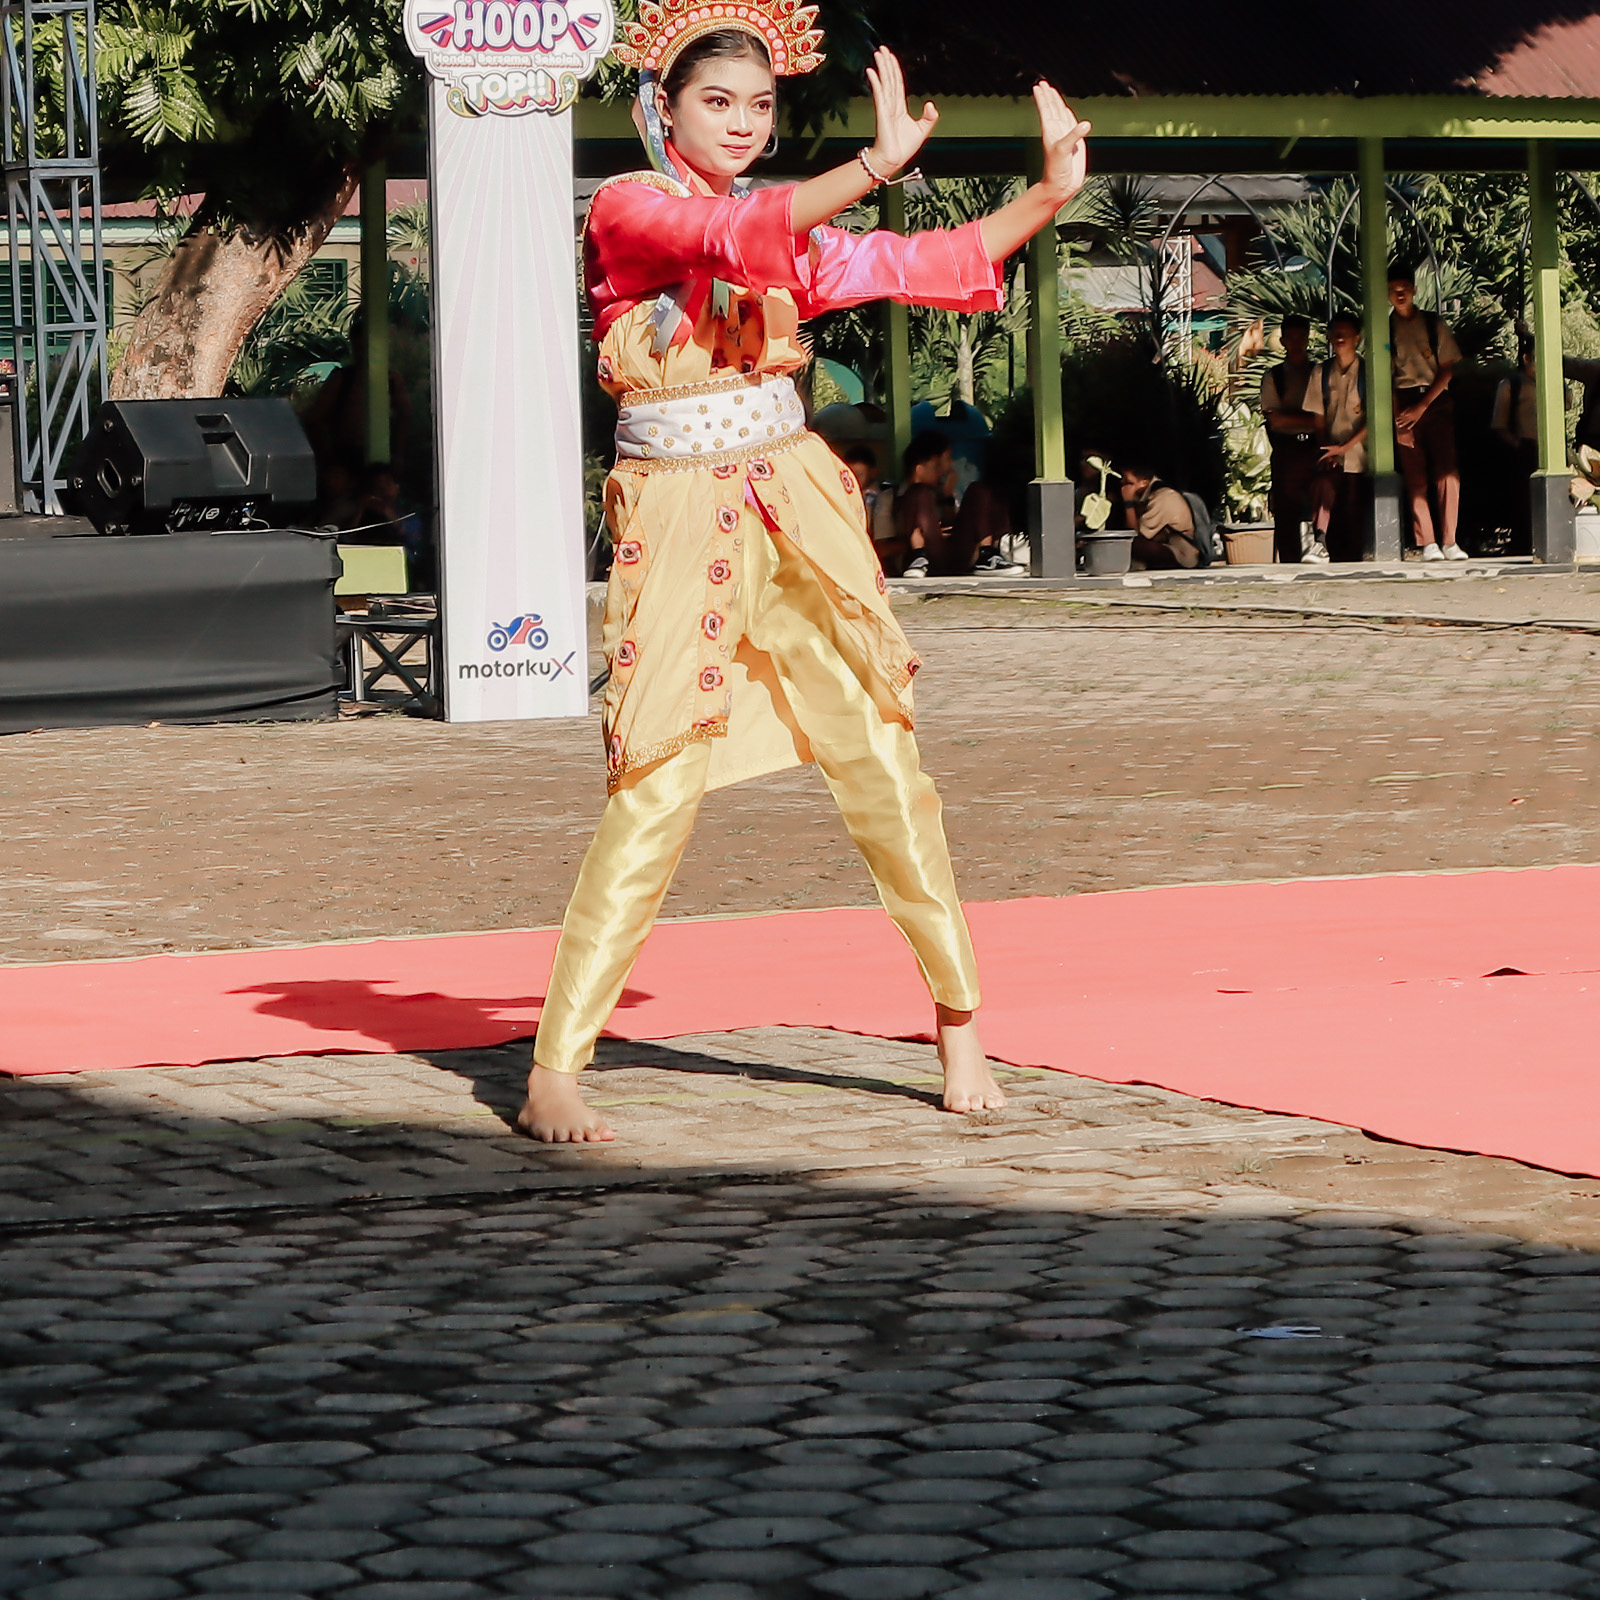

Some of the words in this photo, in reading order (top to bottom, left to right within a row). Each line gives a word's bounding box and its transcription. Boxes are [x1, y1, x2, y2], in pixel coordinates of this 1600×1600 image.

[453, 0, 568, 50] HOOP
[433, 53, 475, 66] Honda
[478, 54, 532, 67] Bersama
[535, 54, 583, 68] Sekolah
[462, 69, 554, 107] TOP!!
[459, 651, 576, 681] motorkuX
